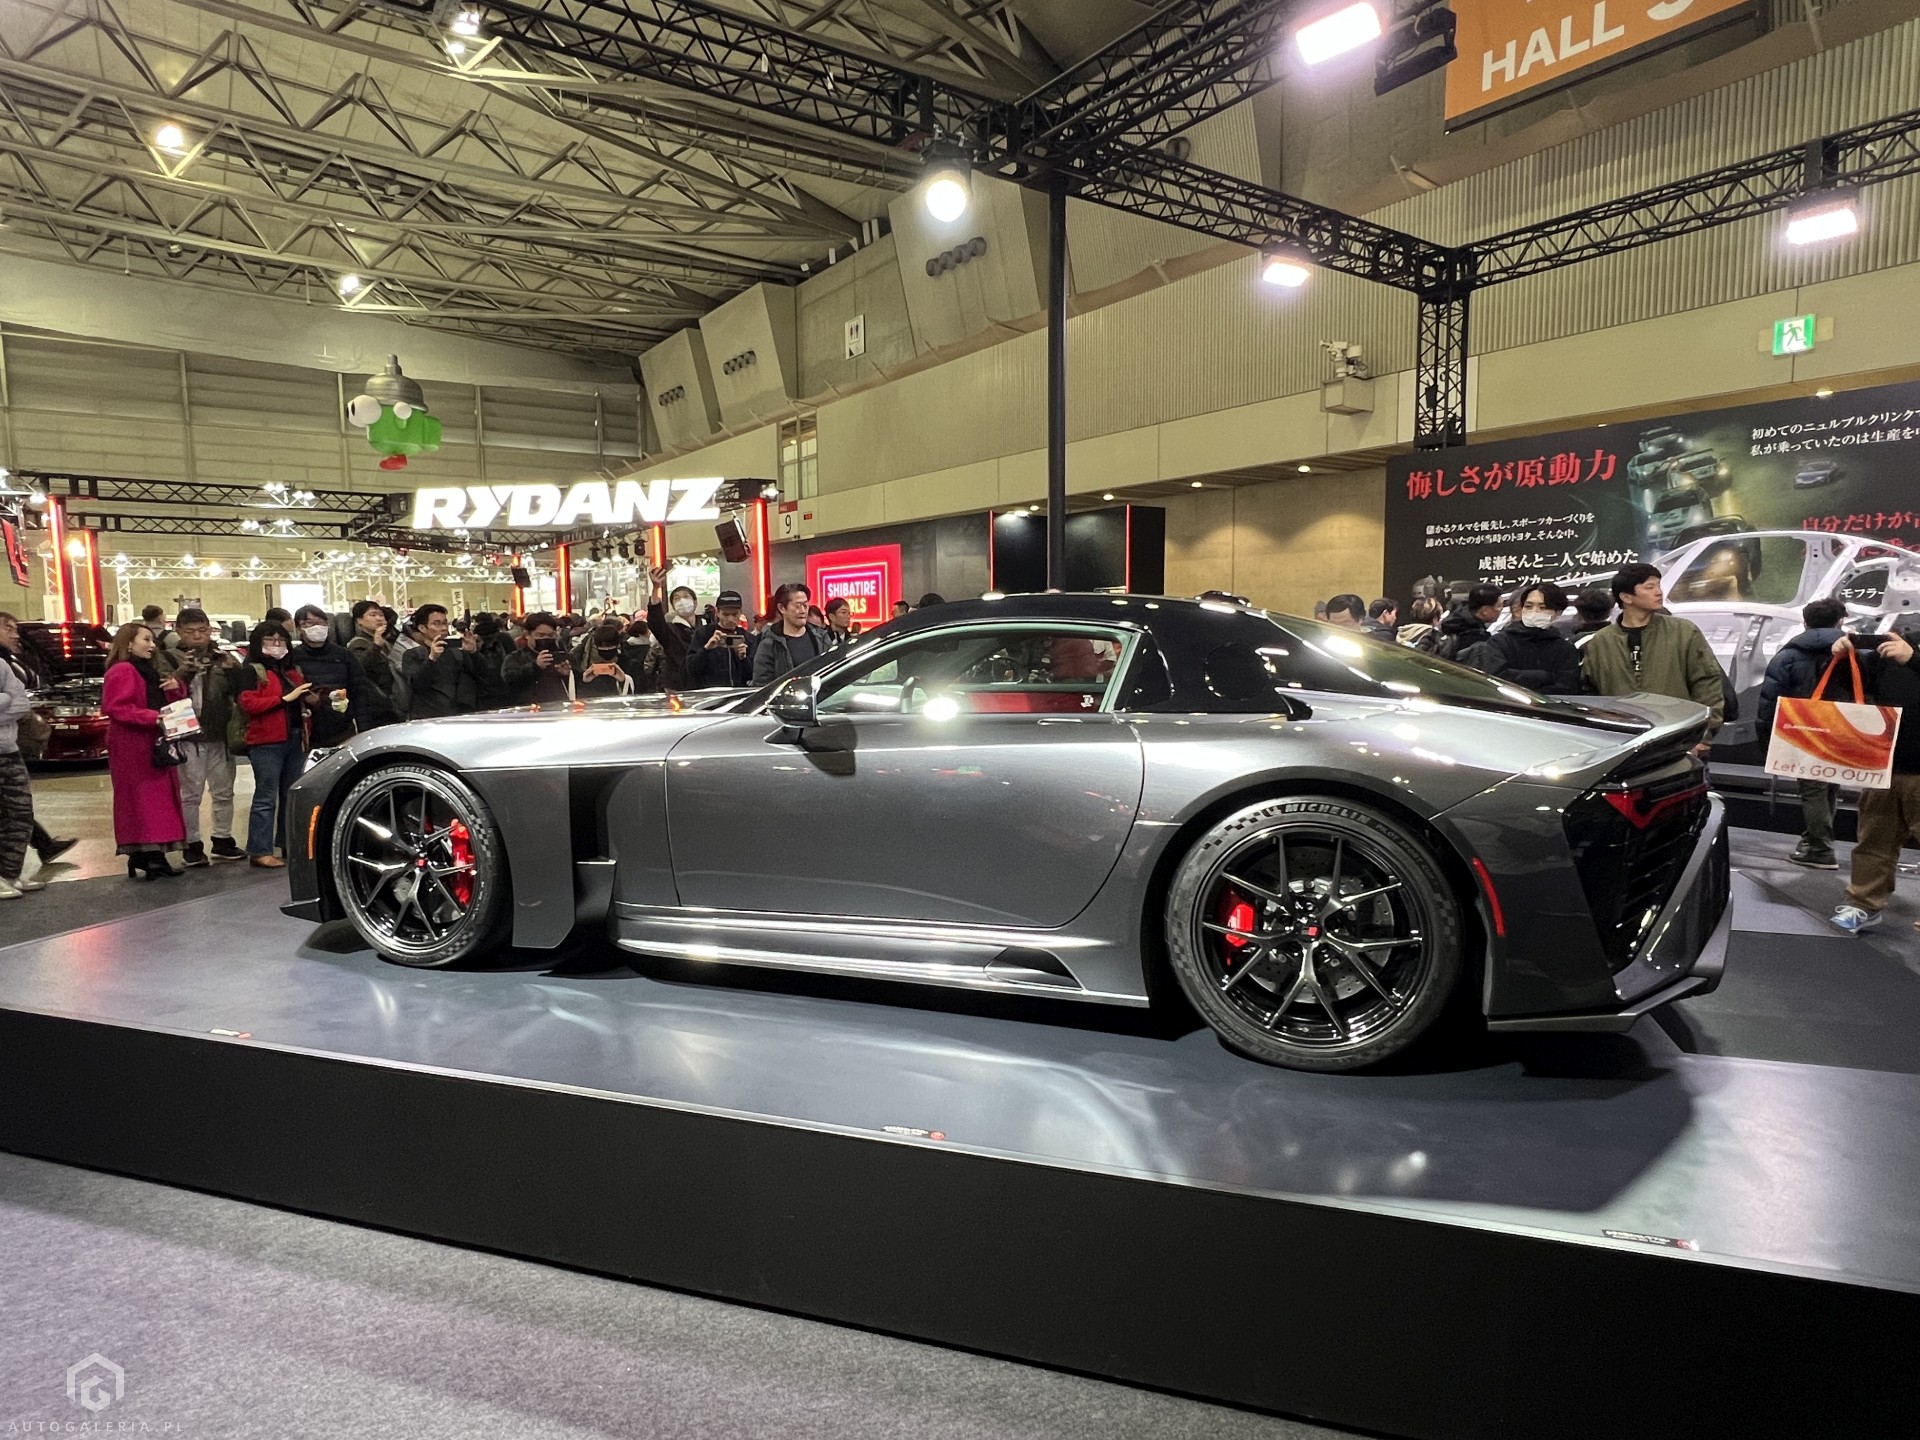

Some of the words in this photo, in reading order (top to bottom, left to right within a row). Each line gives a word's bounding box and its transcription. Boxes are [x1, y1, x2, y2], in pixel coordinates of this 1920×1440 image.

[1481, 2, 1625, 92] HALL
[1750, 427, 1920, 456] 私が乗っていたのは生産を
[1407, 449, 1617, 500] 悔しさが原動力
[413, 477, 725, 529] RYDANZ
[785, 514, 792, 534] 9
[1803, 511, 1920, 532] 自分だけが
[1478, 549, 1639, 571] 成瀬さんと二人で始めた
[827, 580, 877, 598] SHIBATIRE
[848, 597, 867, 614] RLS
[1772, 760, 1805, 775] Let's
[1810, 765, 1836, 778] GO
[1842, 769, 1884, 785] OUT!
[1284, 803, 1371, 824] MICHELIN
